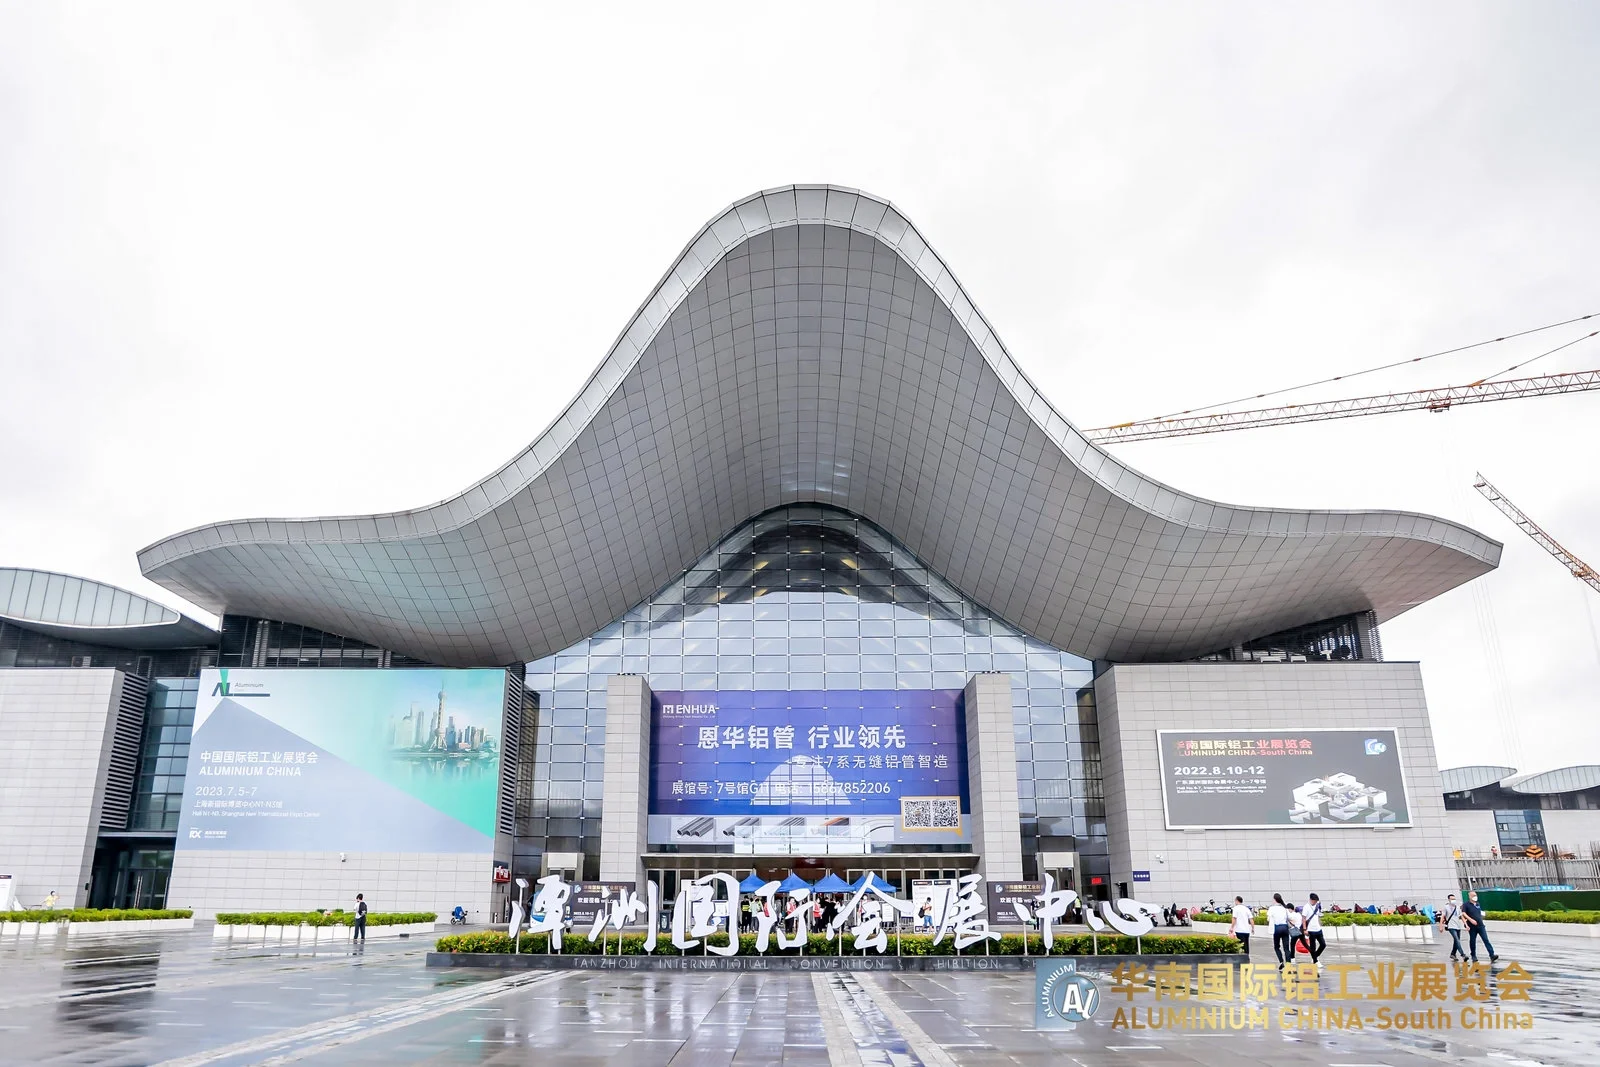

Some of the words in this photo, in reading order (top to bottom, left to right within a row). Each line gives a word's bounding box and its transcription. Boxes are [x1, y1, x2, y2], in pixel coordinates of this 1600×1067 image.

[676, 704, 716, 714] ENHUA
[698, 726, 795, 749] 恩华铝管
[808, 725, 906, 749] 行业领先
[200, 751, 319, 764] 中国国际铝工业展览会
[1288, 748, 1313, 756] China
[796, 754, 949, 769] 专注7系无缝铝管智造
[198, 766, 263, 777] ALUMINIUM
[266, 766, 302, 777] CHINA
[1174, 766, 1265, 776] 2022.8.10-12
[195, 786, 258, 797] 2023.7.5-7
[672, 782, 712, 795] 展馆号:
[574, 958, 637, 968] TANZHOU
[659, 958, 769, 969] INTERNATIONAL
[937, 958, 998, 969] HIBITION
